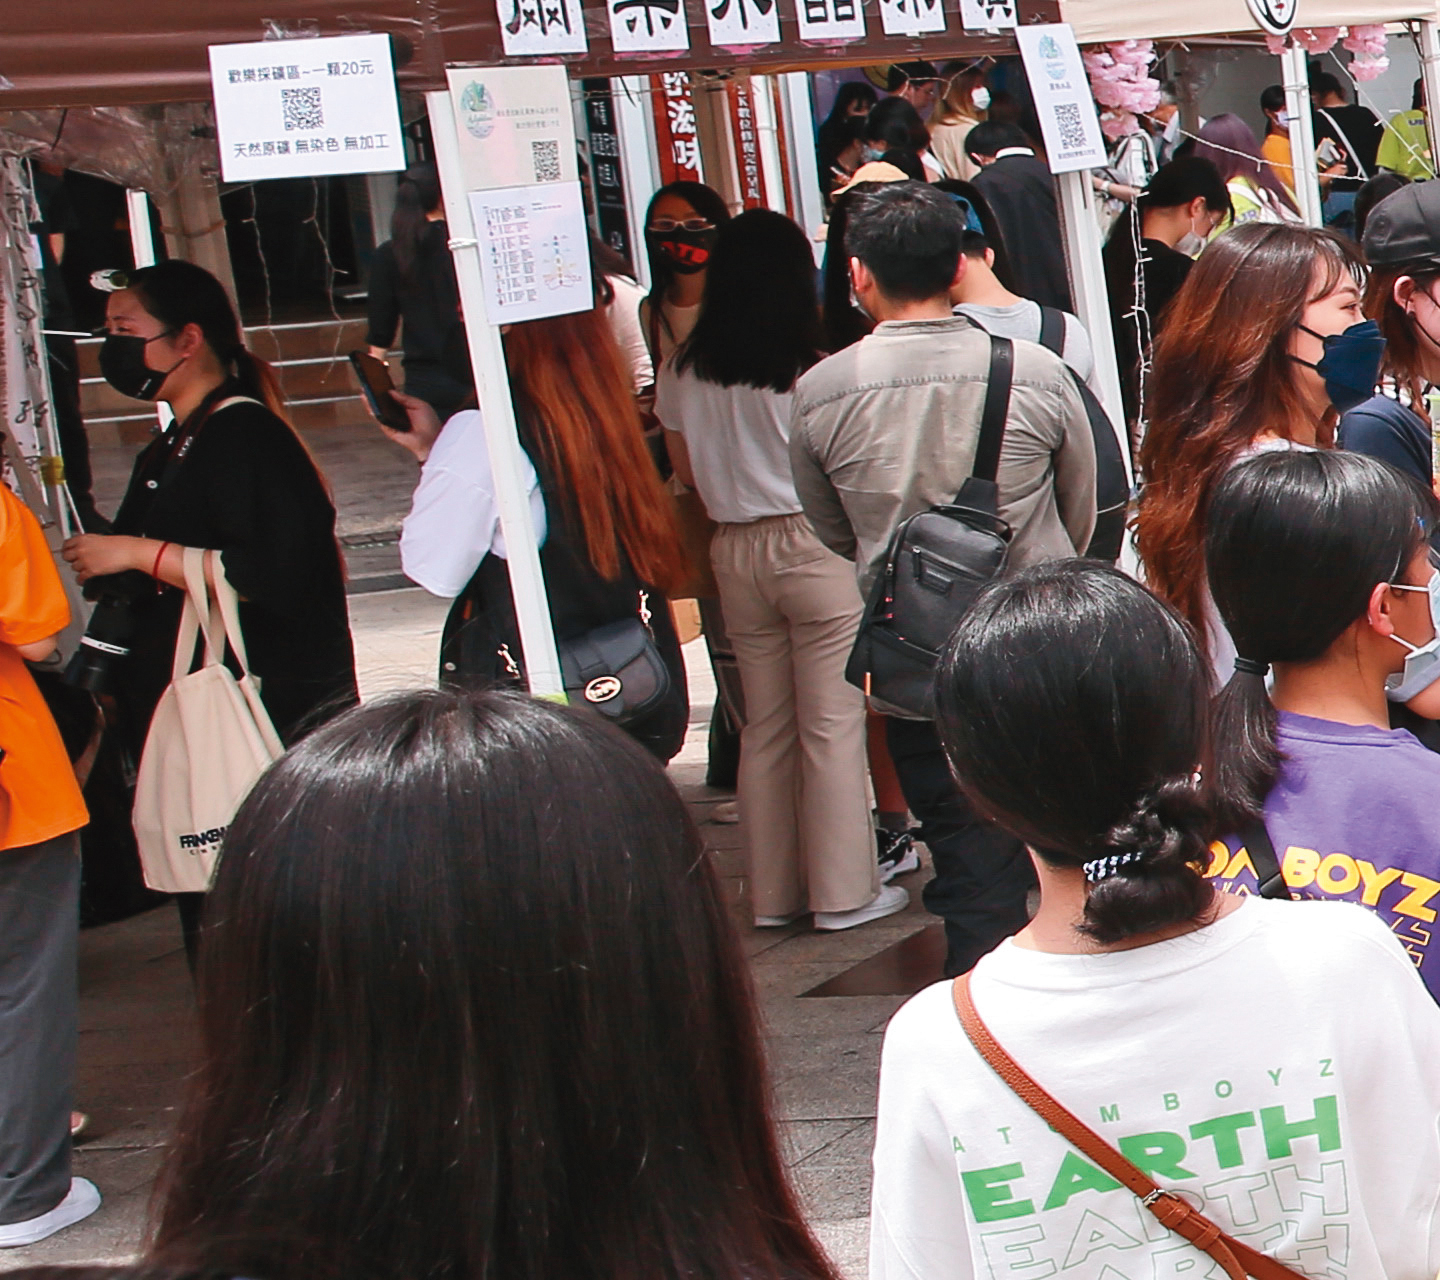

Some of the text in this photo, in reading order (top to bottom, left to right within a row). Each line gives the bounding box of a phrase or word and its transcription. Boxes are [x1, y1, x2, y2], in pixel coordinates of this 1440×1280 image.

[344, 133, 390, 151] 無加工
[961, 1095, 1342, 1224] EARTH
